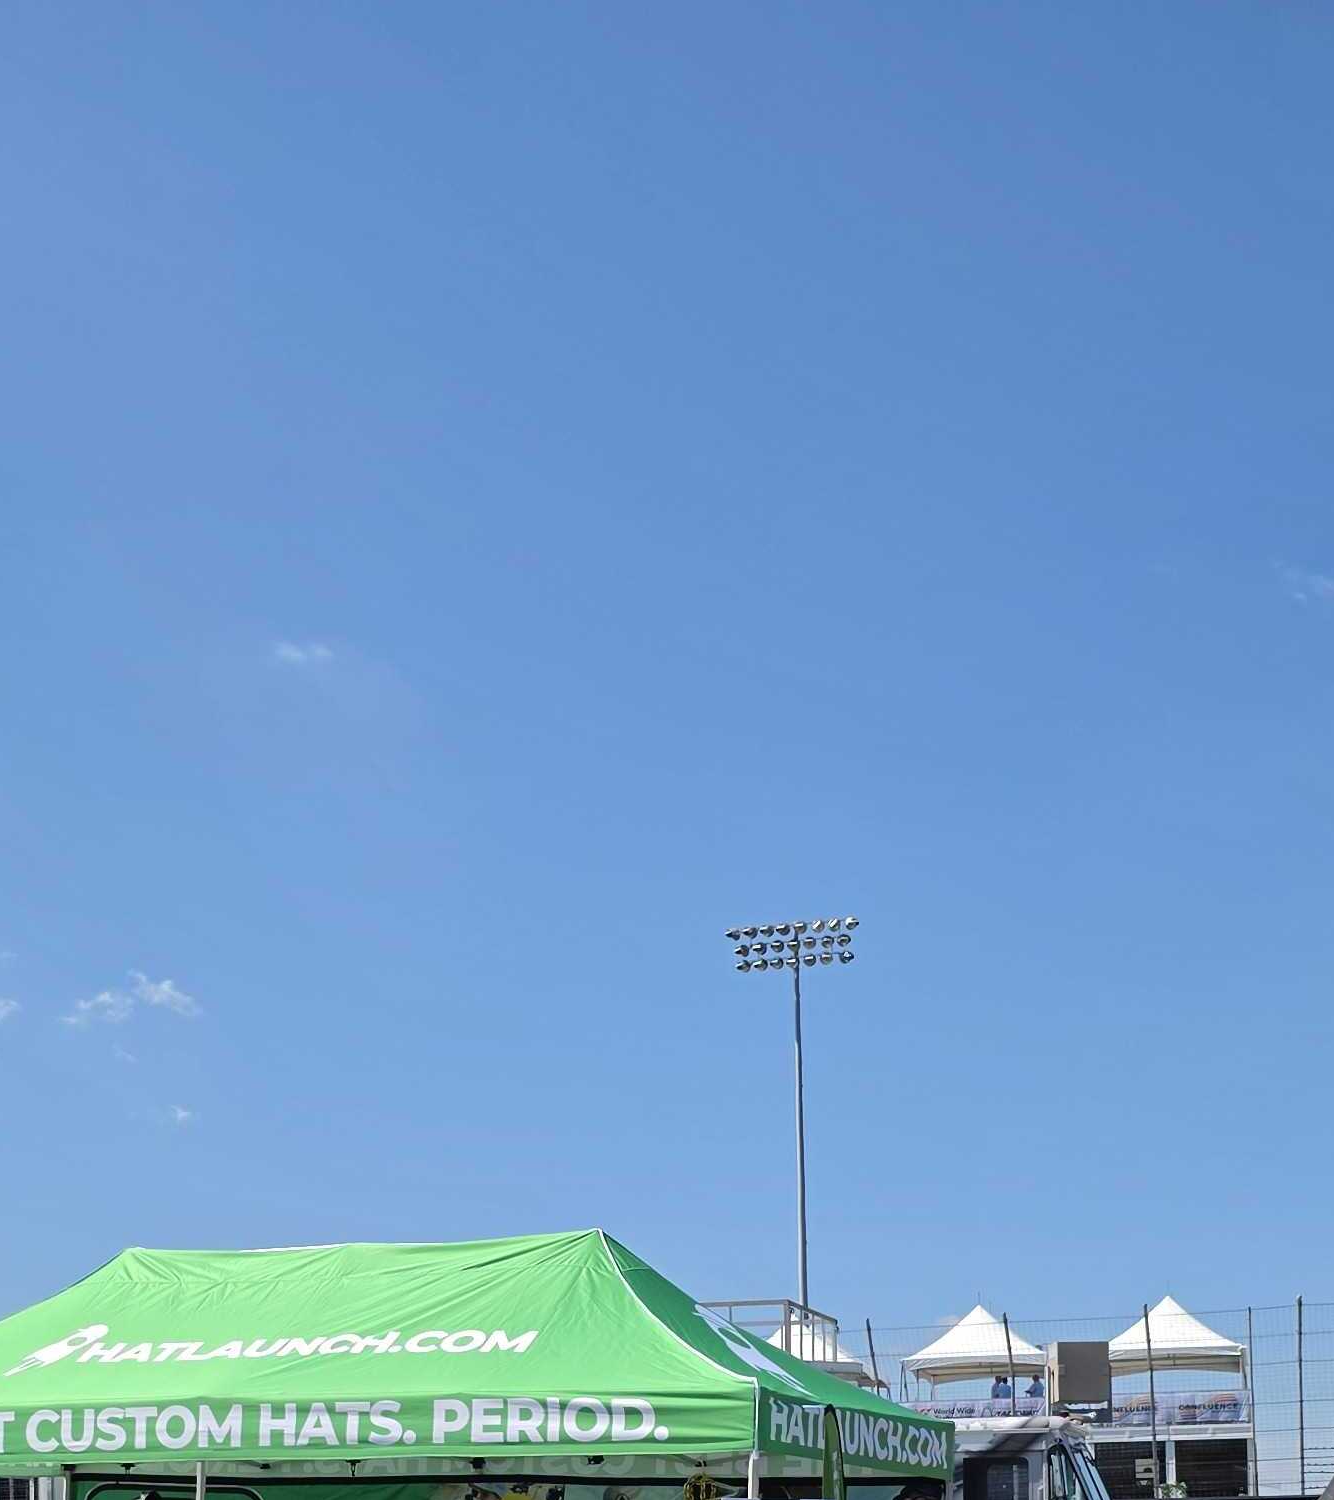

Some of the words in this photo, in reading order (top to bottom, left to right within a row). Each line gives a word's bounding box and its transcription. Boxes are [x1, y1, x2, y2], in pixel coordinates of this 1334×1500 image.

[76, 1329, 539, 1364] HATLAUNCH.COM
[25, 1403, 243, 1454] CUSTOM
[259, 1400, 417, 1447] HATS.
[432, 1397, 670, 1444] PERIOD.
[769, 1397, 948, 1470] HATLUNCH.COM
